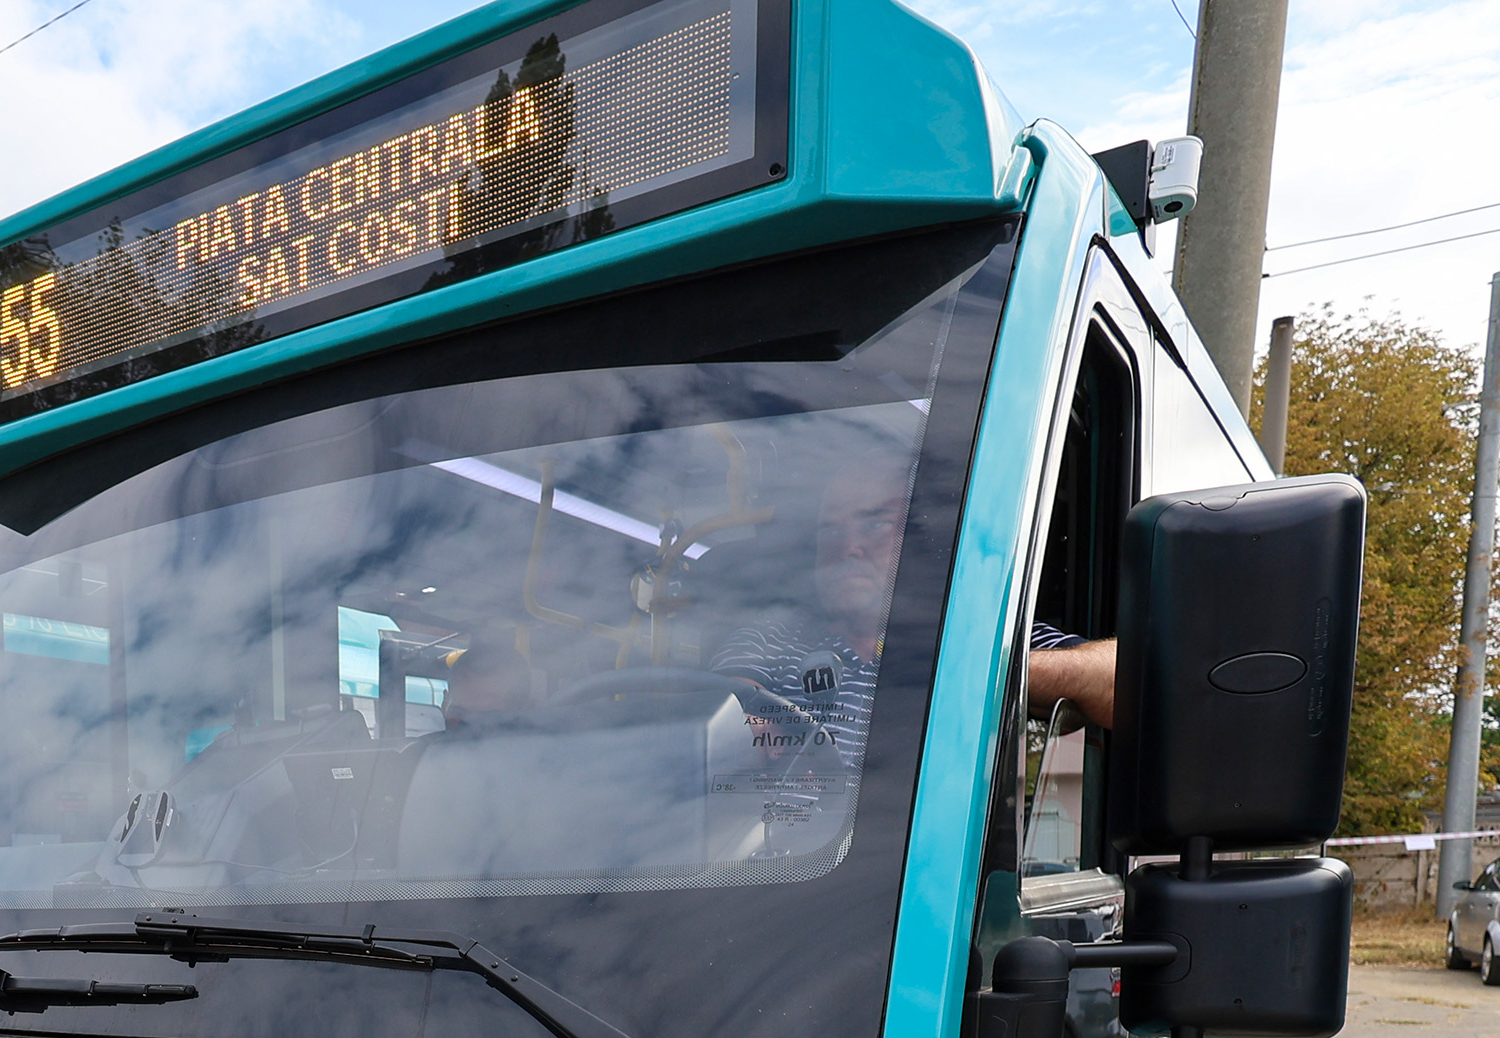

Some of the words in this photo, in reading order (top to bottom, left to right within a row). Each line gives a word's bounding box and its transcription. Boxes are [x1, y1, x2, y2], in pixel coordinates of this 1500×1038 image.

[176, 182, 289, 270] PIATA
[301, 87, 540, 221] CENTRALA
[238, 234, 315, 307] SAT
[328, 182, 459, 275] COSTI
[0, 271, 60, 388] 55
